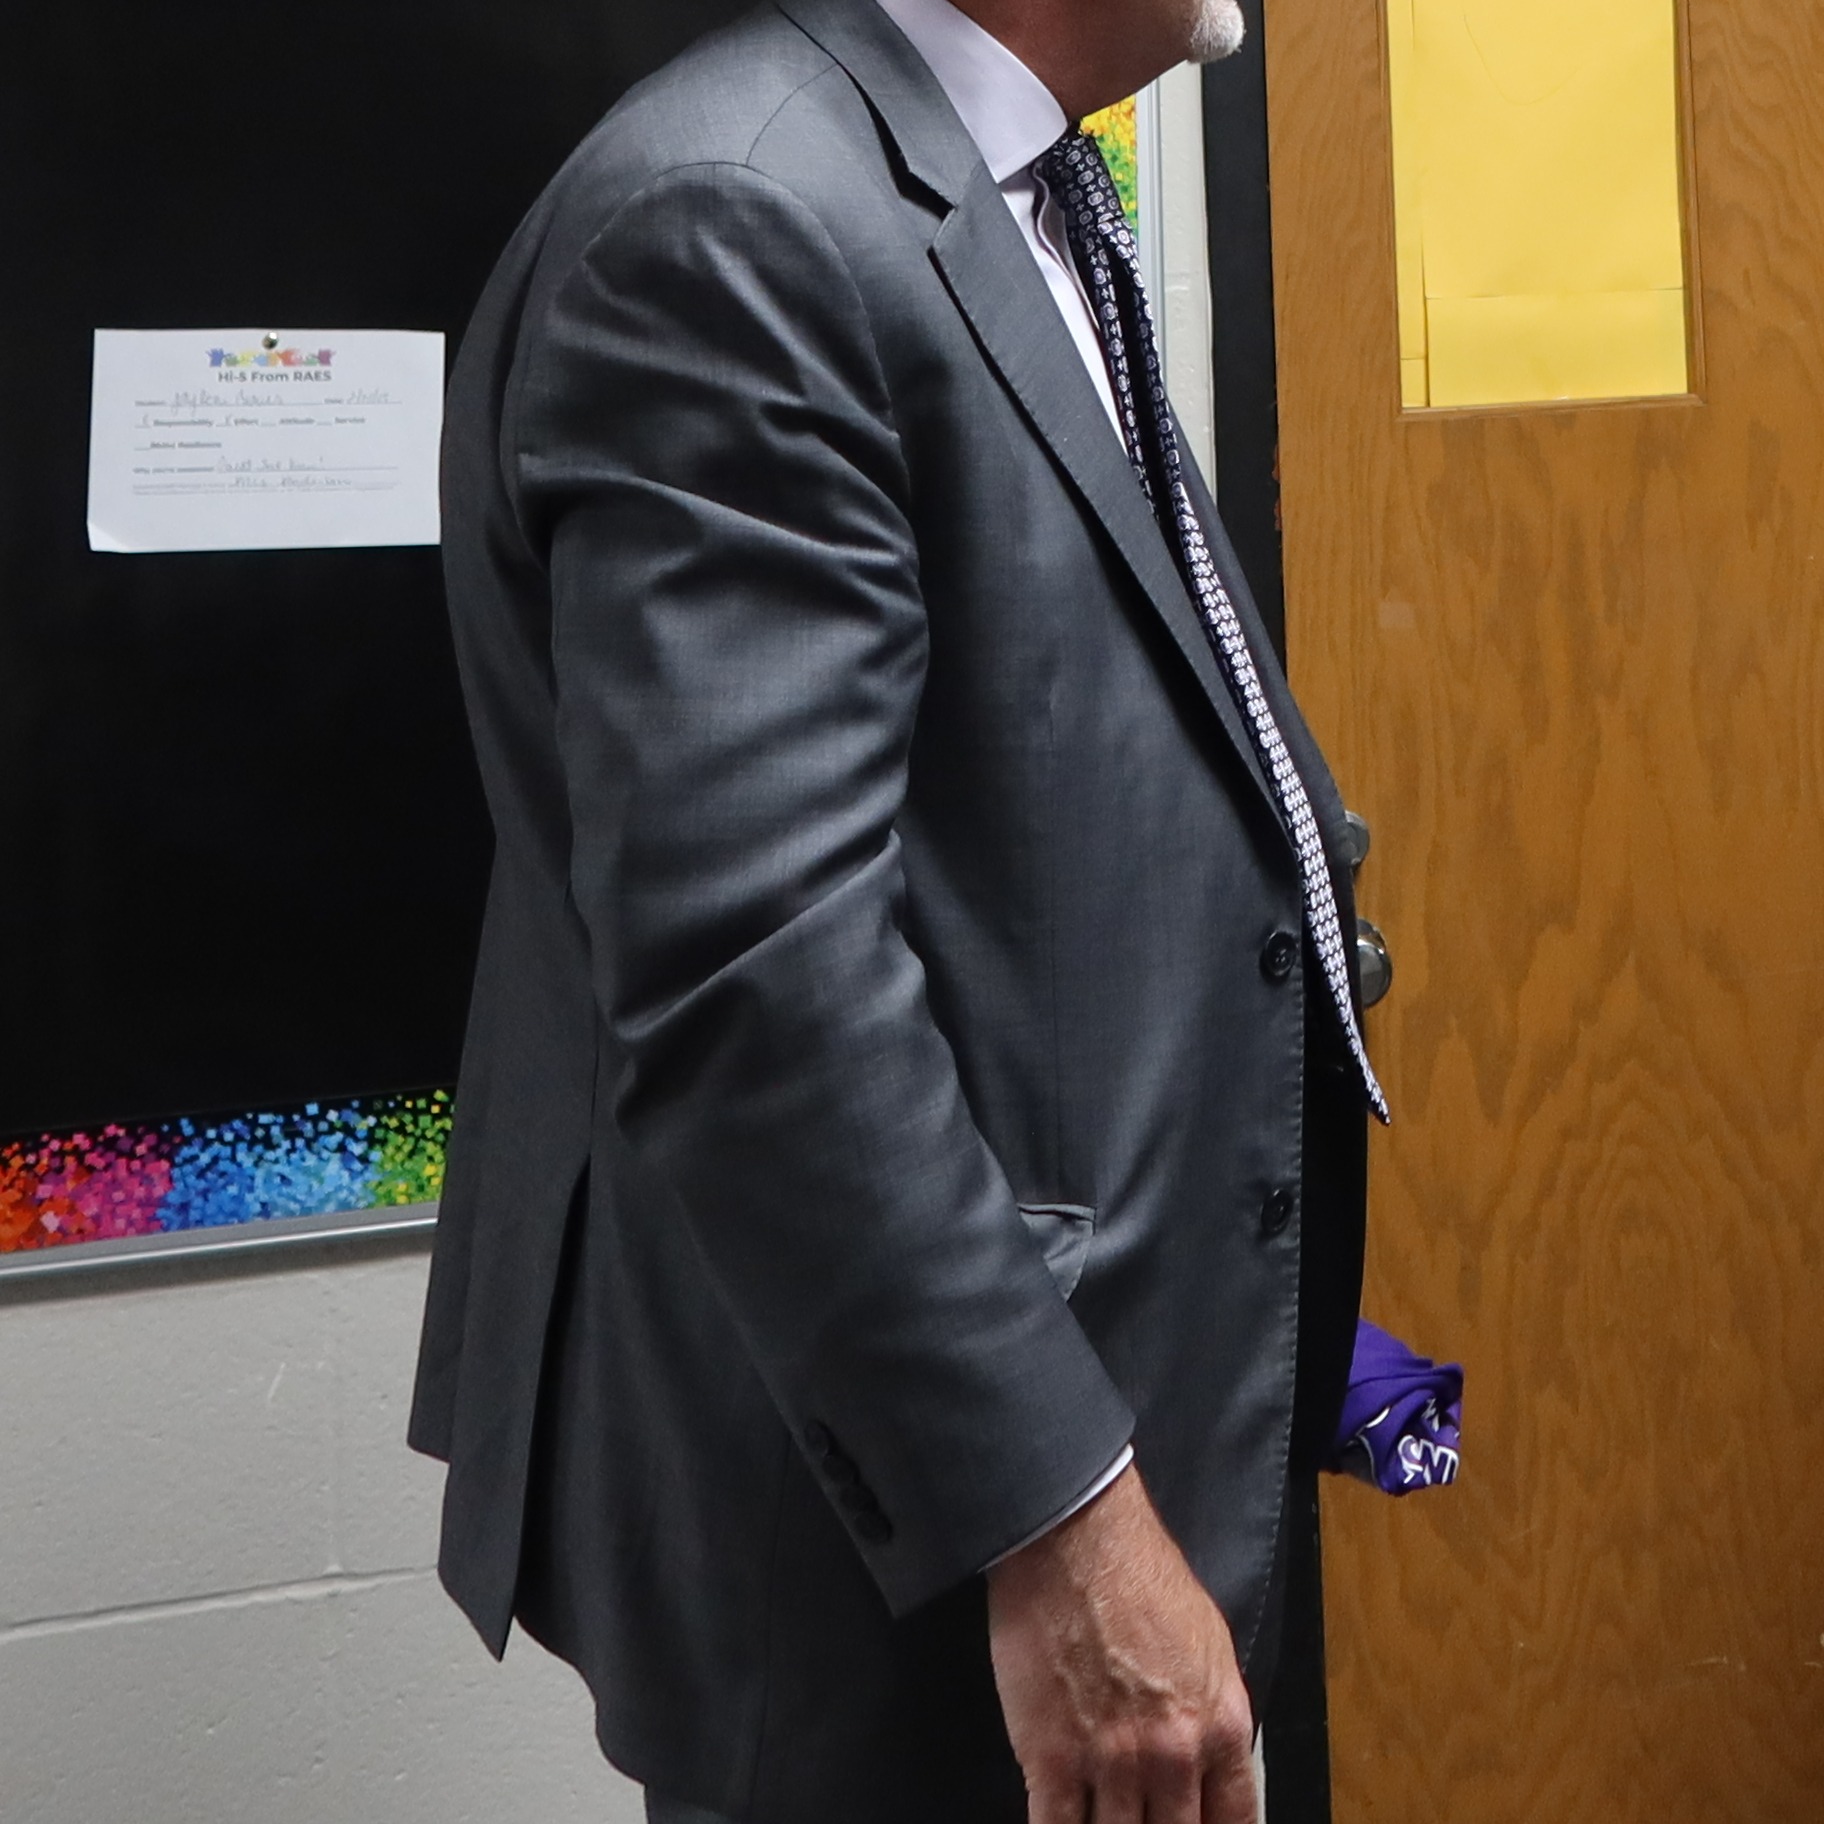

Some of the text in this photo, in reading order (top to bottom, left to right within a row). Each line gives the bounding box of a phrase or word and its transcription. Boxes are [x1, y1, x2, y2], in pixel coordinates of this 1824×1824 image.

[218, 370, 332, 382] Hi-5 From RAES
